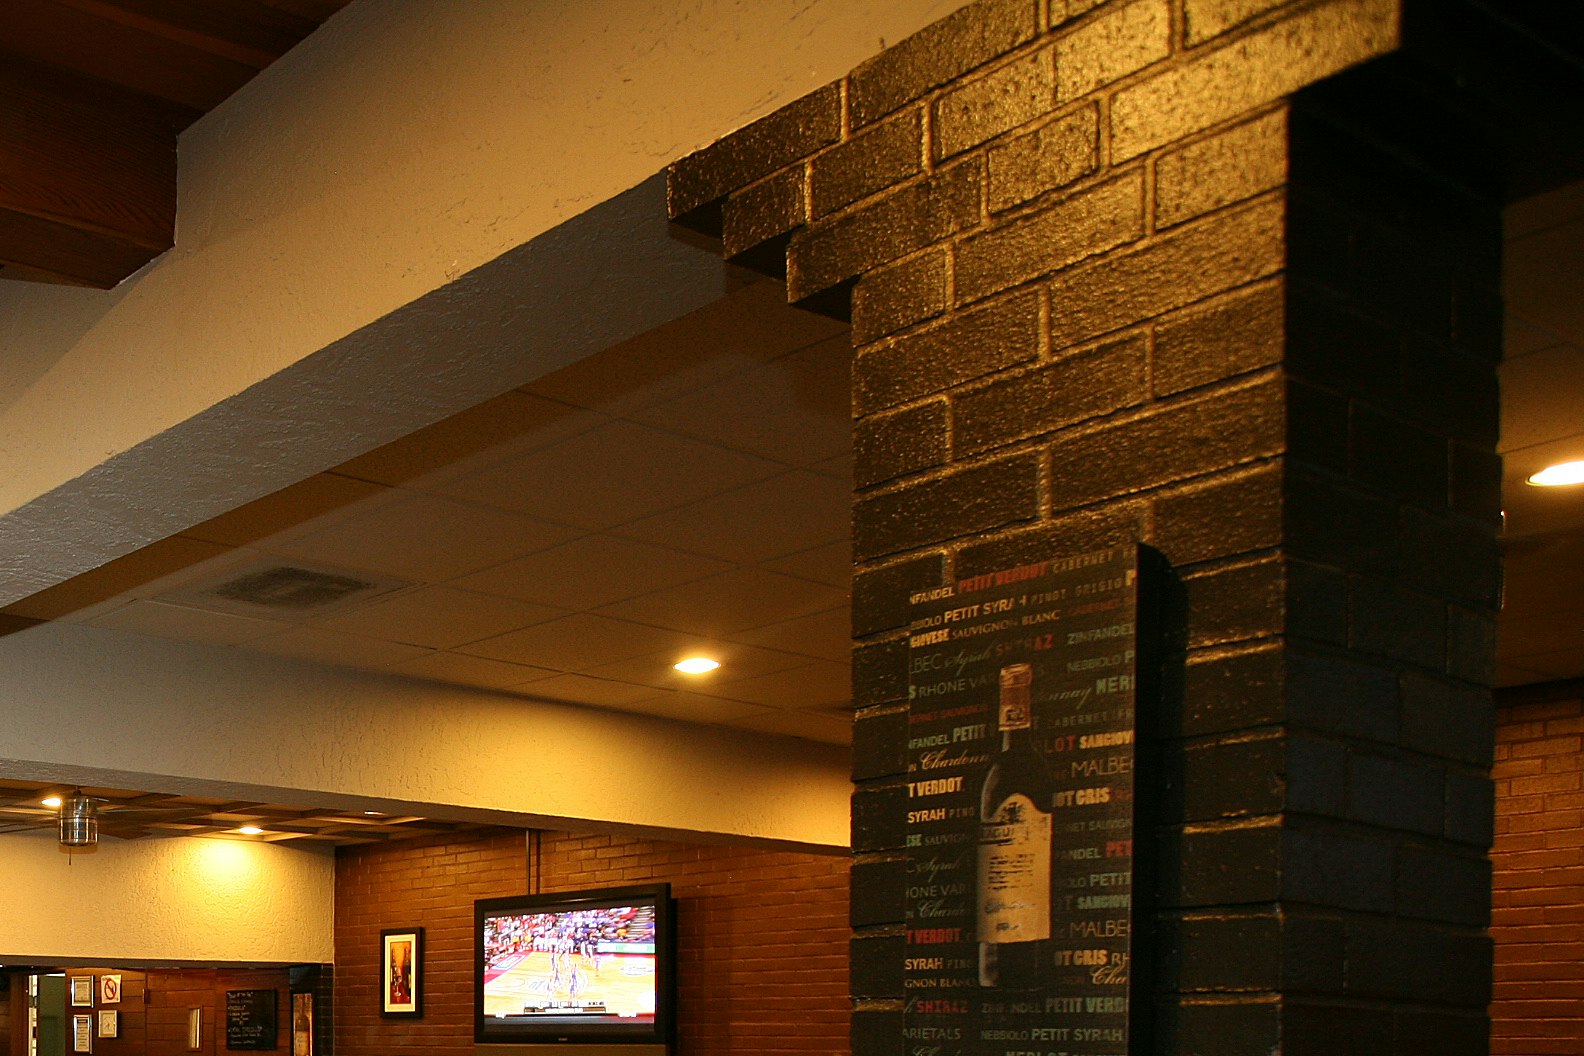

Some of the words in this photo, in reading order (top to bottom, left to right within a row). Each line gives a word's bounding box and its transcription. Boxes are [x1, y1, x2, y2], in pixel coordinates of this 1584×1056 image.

[944, 604, 980, 623] PETIT
[1022, 609, 1061, 626] BLANC
[919, 678, 965, 698] RHONE
[917, 776, 963, 797] VERDOT
[1076, 786, 1111, 806] GRIS
[907, 808, 945, 824] SYRAH
[1070, 918, 1130, 939] MALBE
[904, 957, 943, 970] SYRAH
[904, 978, 936, 989] GNON
[981, 1001, 1042, 1014] ZINFNDEL
[1045, 997, 1083, 1013] PETIT
[1031, 1028, 1070, 1041] PETIT
[1073, 1028, 1123, 1042] SYRAH
